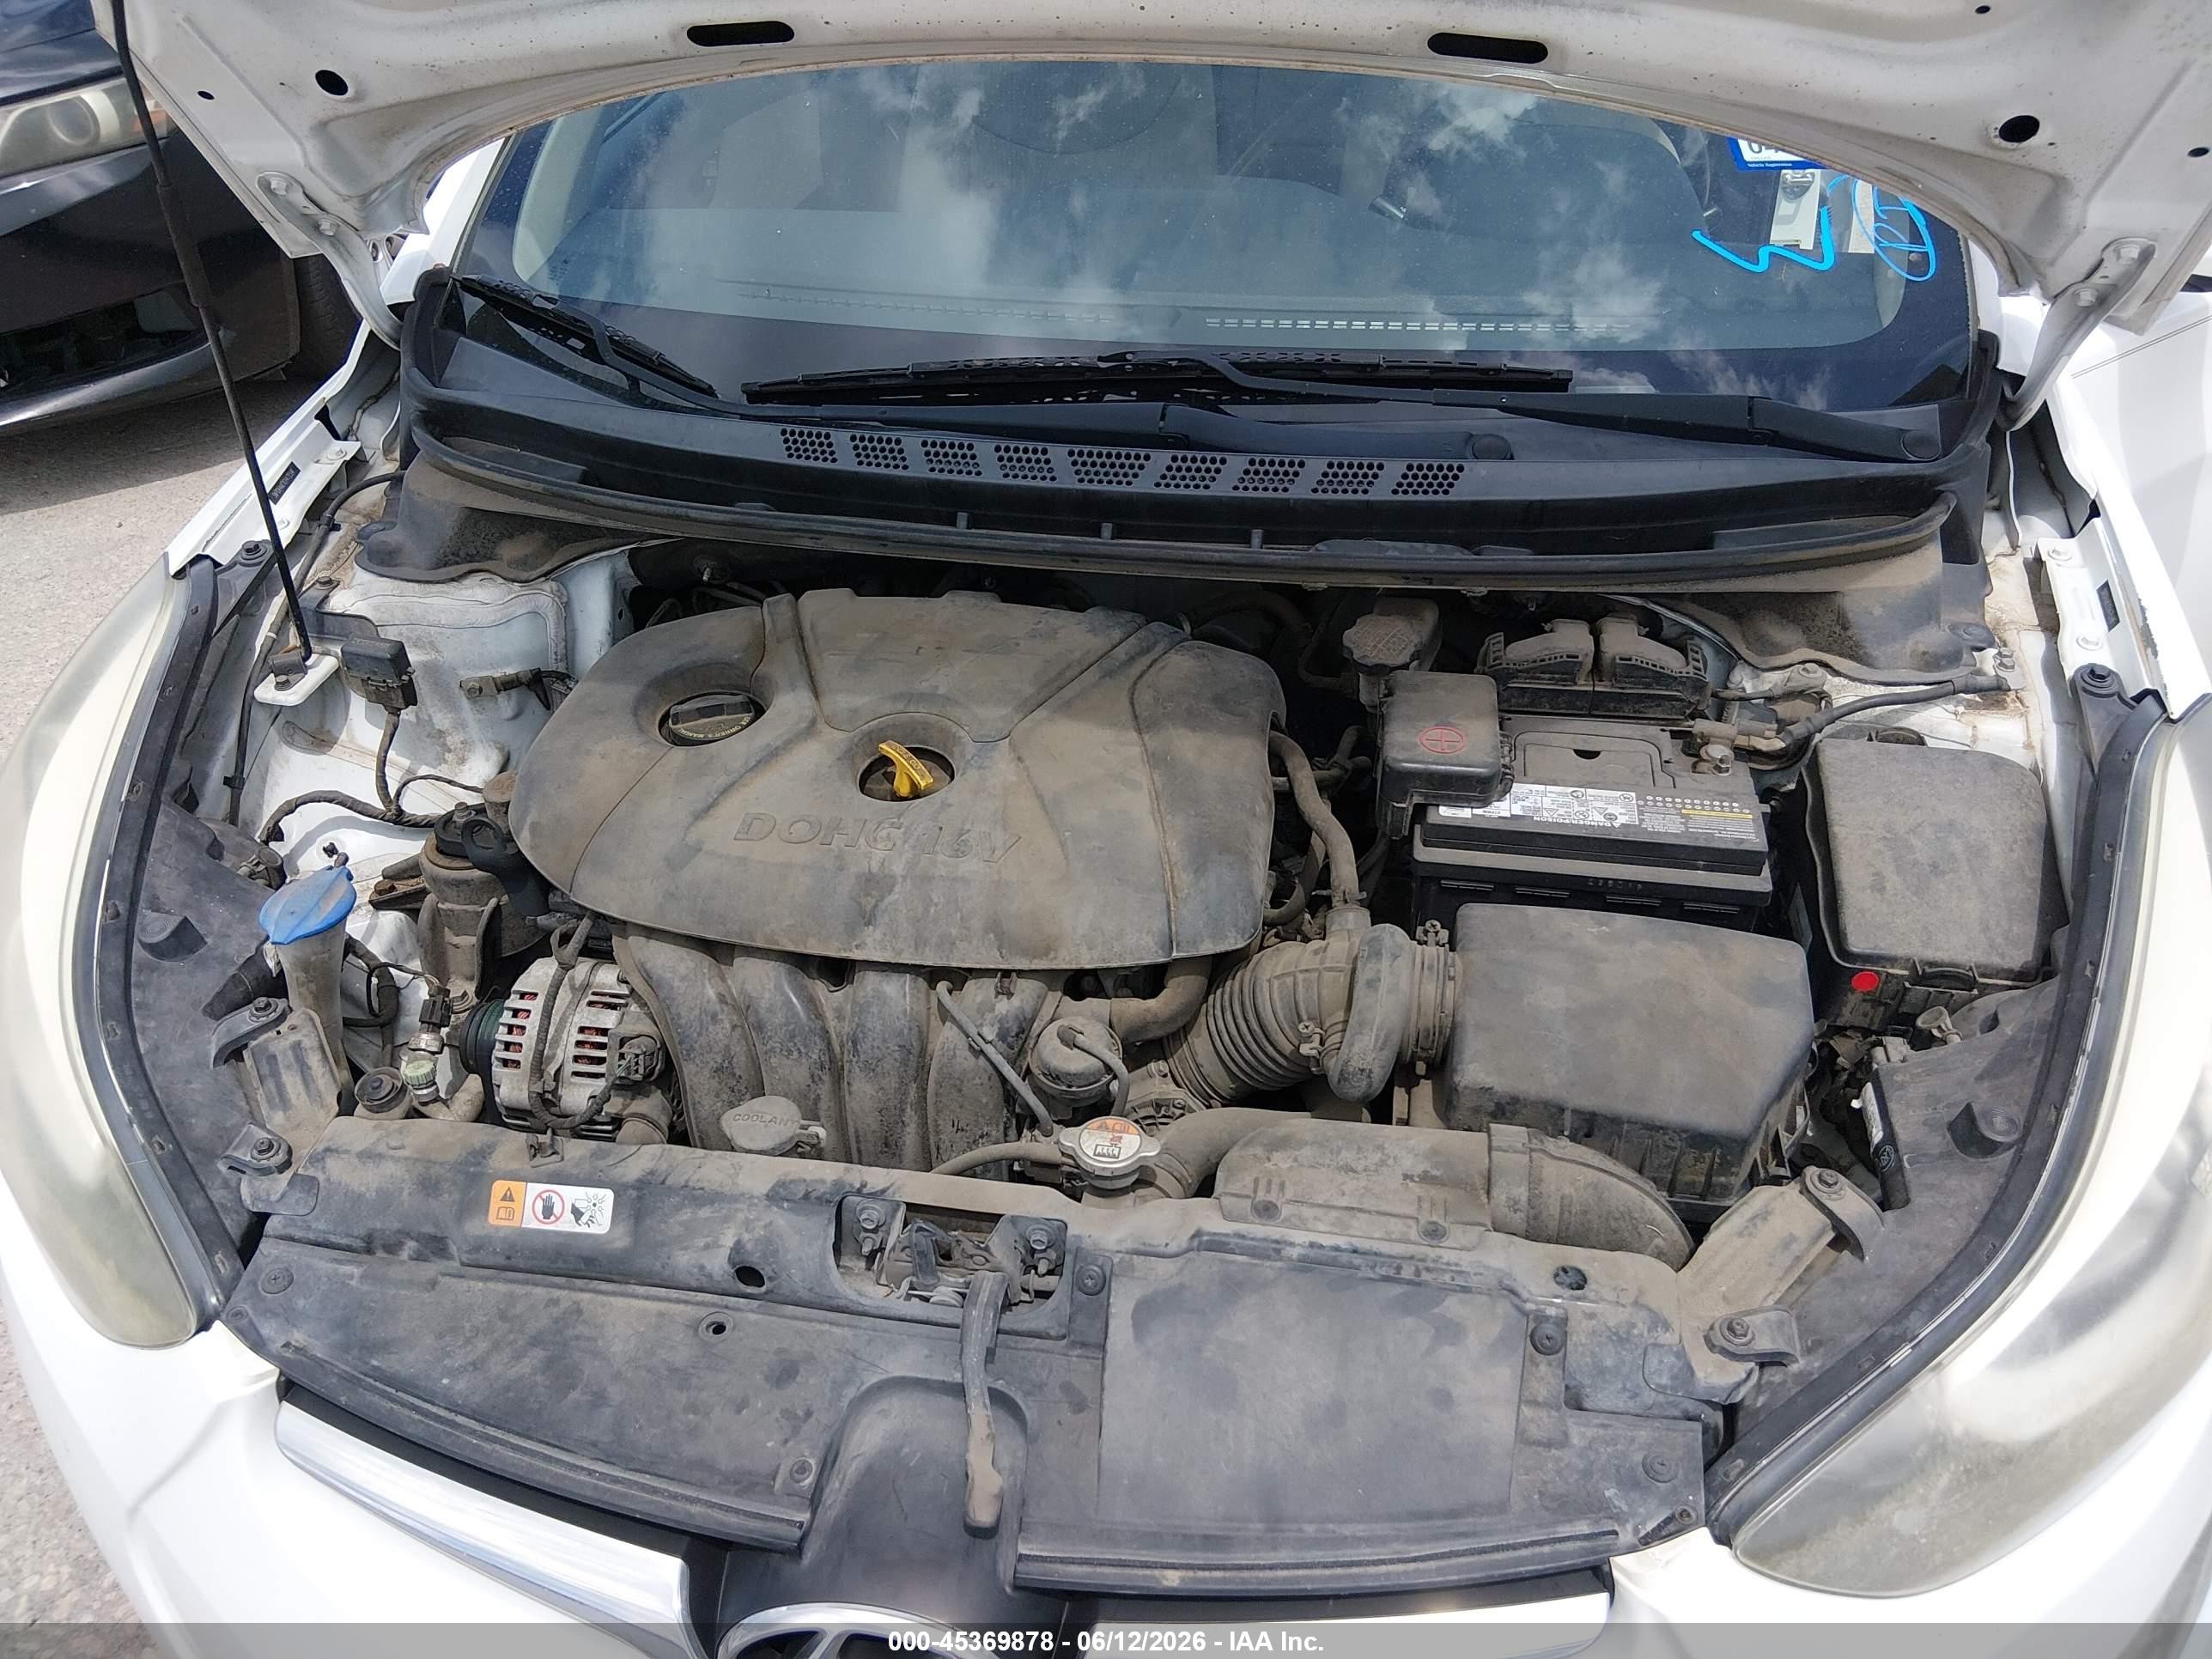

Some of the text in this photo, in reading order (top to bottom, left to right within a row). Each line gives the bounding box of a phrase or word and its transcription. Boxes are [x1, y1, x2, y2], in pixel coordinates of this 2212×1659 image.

[732, 811, 1023, 864] DOHC 16V
[732, 1113, 800, 1127] COOLANT
